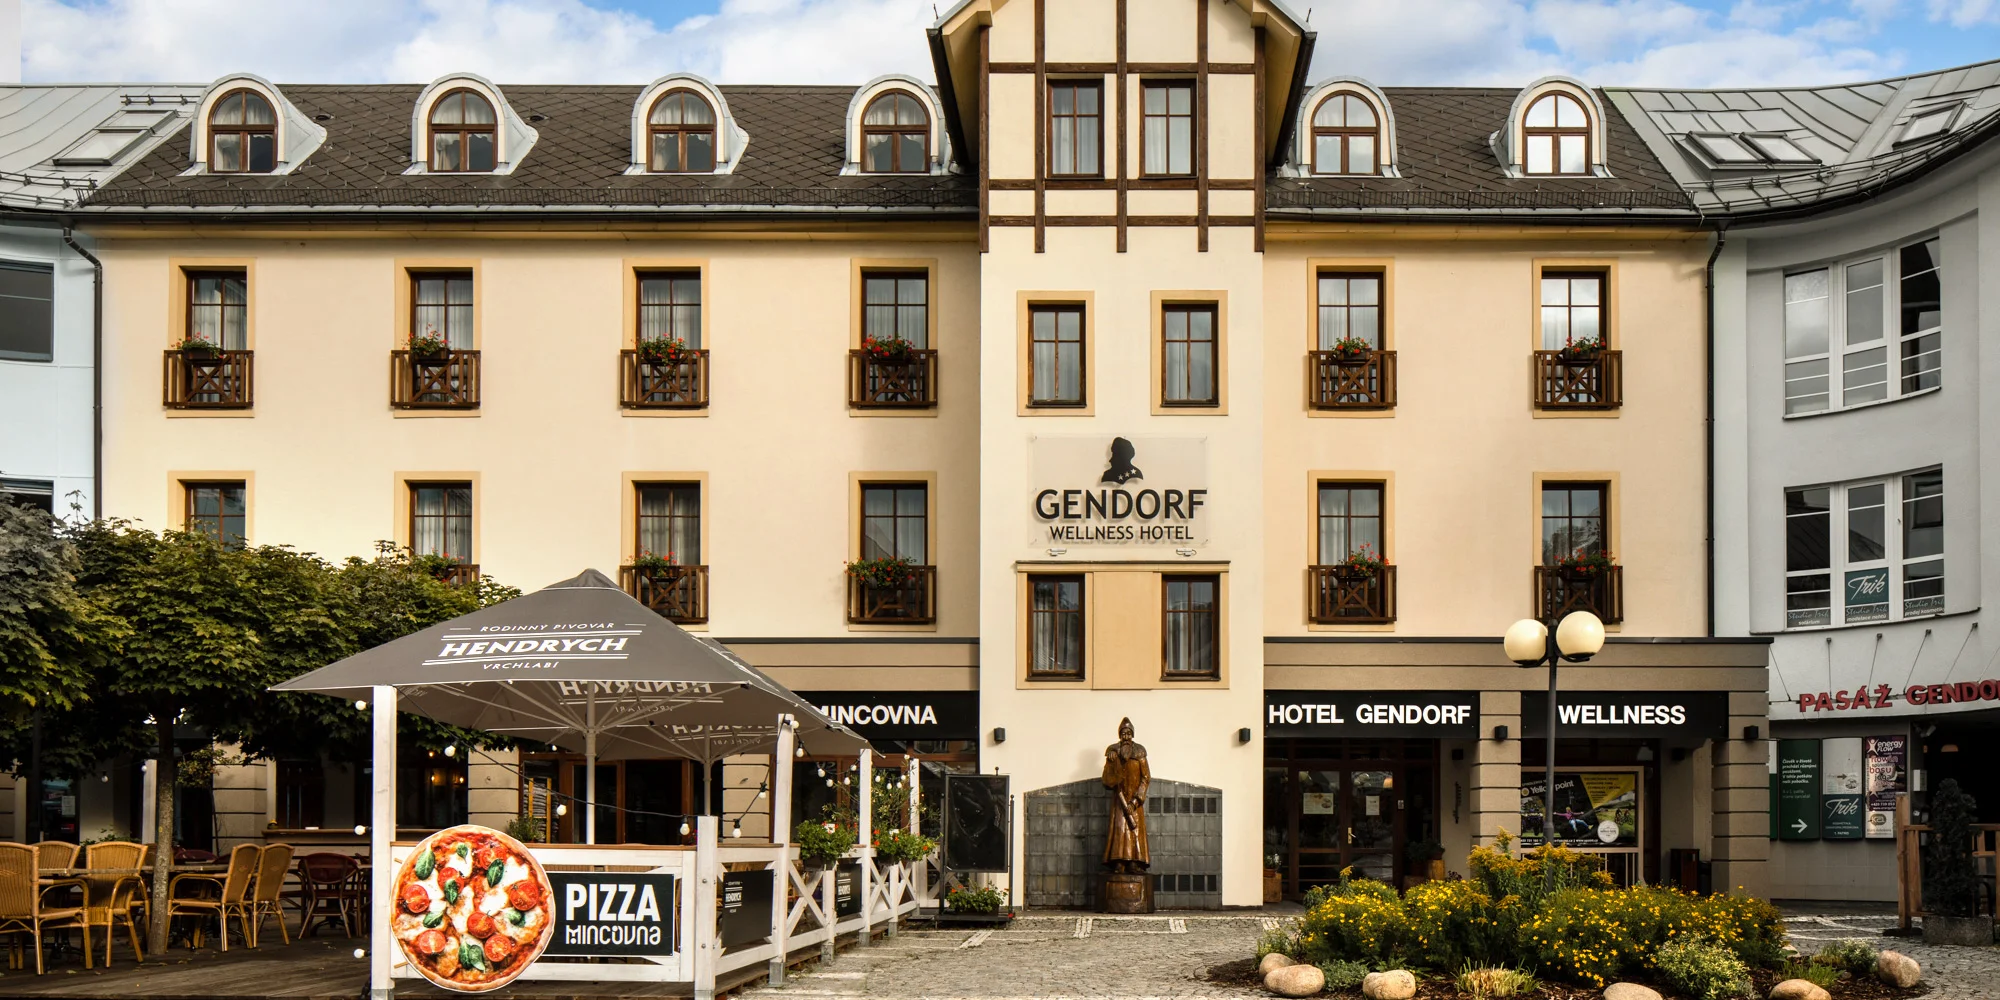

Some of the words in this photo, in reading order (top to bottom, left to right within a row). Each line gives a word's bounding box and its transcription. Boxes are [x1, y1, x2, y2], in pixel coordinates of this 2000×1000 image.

[1036, 489, 1207, 519] GENDORF
[1050, 525, 1133, 540] WELLNESS
[1140, 525, 1194, 540] HOTEL
[1847, 573, 1887, 601] Trik
[438, 637, 628, 657] HENDRYCH
[1799, 684, 1893, 713] PASÁŽ
[1905, 679, 2000, 706] GENDO
[1269, 704, 1344, 724] HOTEL
[1356, 704, 1471, 724] GENDORF
[1558, 705, 1686, 724] WELLNESS
[1877, 740, 1904, 749] energy
[1555, 780, 1575, 791] point
[1825, 798, 1859, 819] Trik
[565, 883, 661, 921] PIZZA
